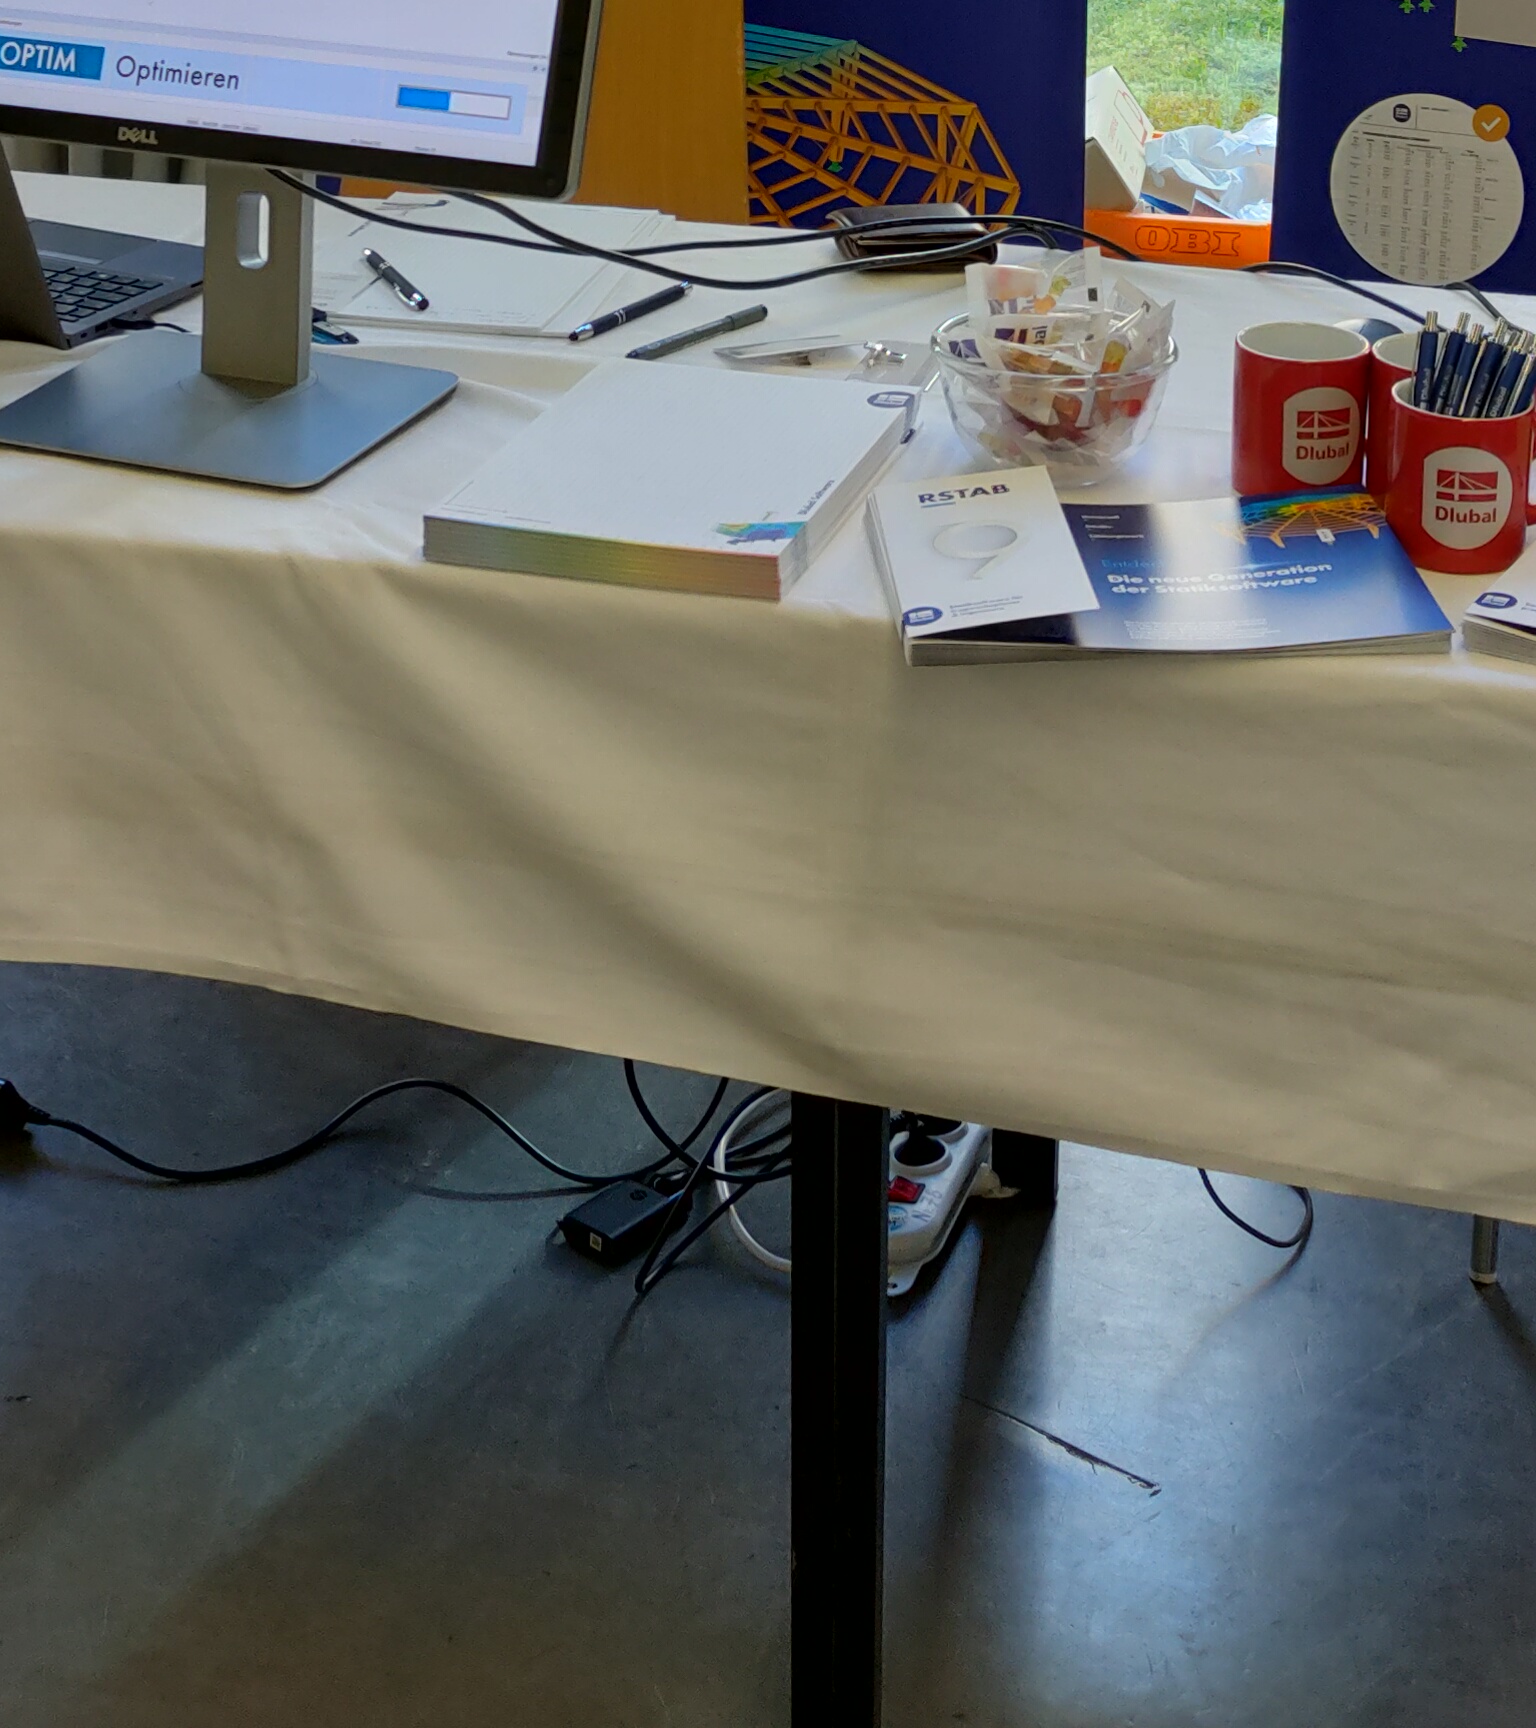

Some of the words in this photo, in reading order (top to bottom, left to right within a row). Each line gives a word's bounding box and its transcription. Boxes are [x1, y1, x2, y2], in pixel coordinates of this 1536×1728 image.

[0, 41, 76, 72] OPTIM
[116, 55, 240, 91] Optimieren
[118, 126, 158, 145] DELL
[1135, 225, 1241, 256] OBI
[1296, 443, 1349, 460] Dlubal
[918, 484, 1009, 504] RSTAB
[1435, 506, 1496, 524] Dlubal
[1107, 574, 1143, 584] Die
[1149, 575, 1202, 584] neue
[1208, 563, 1333, 581] Generation
[1111, 585, 1149, 594] der
[1155, 576, 1318, 593] Statiksoftware
